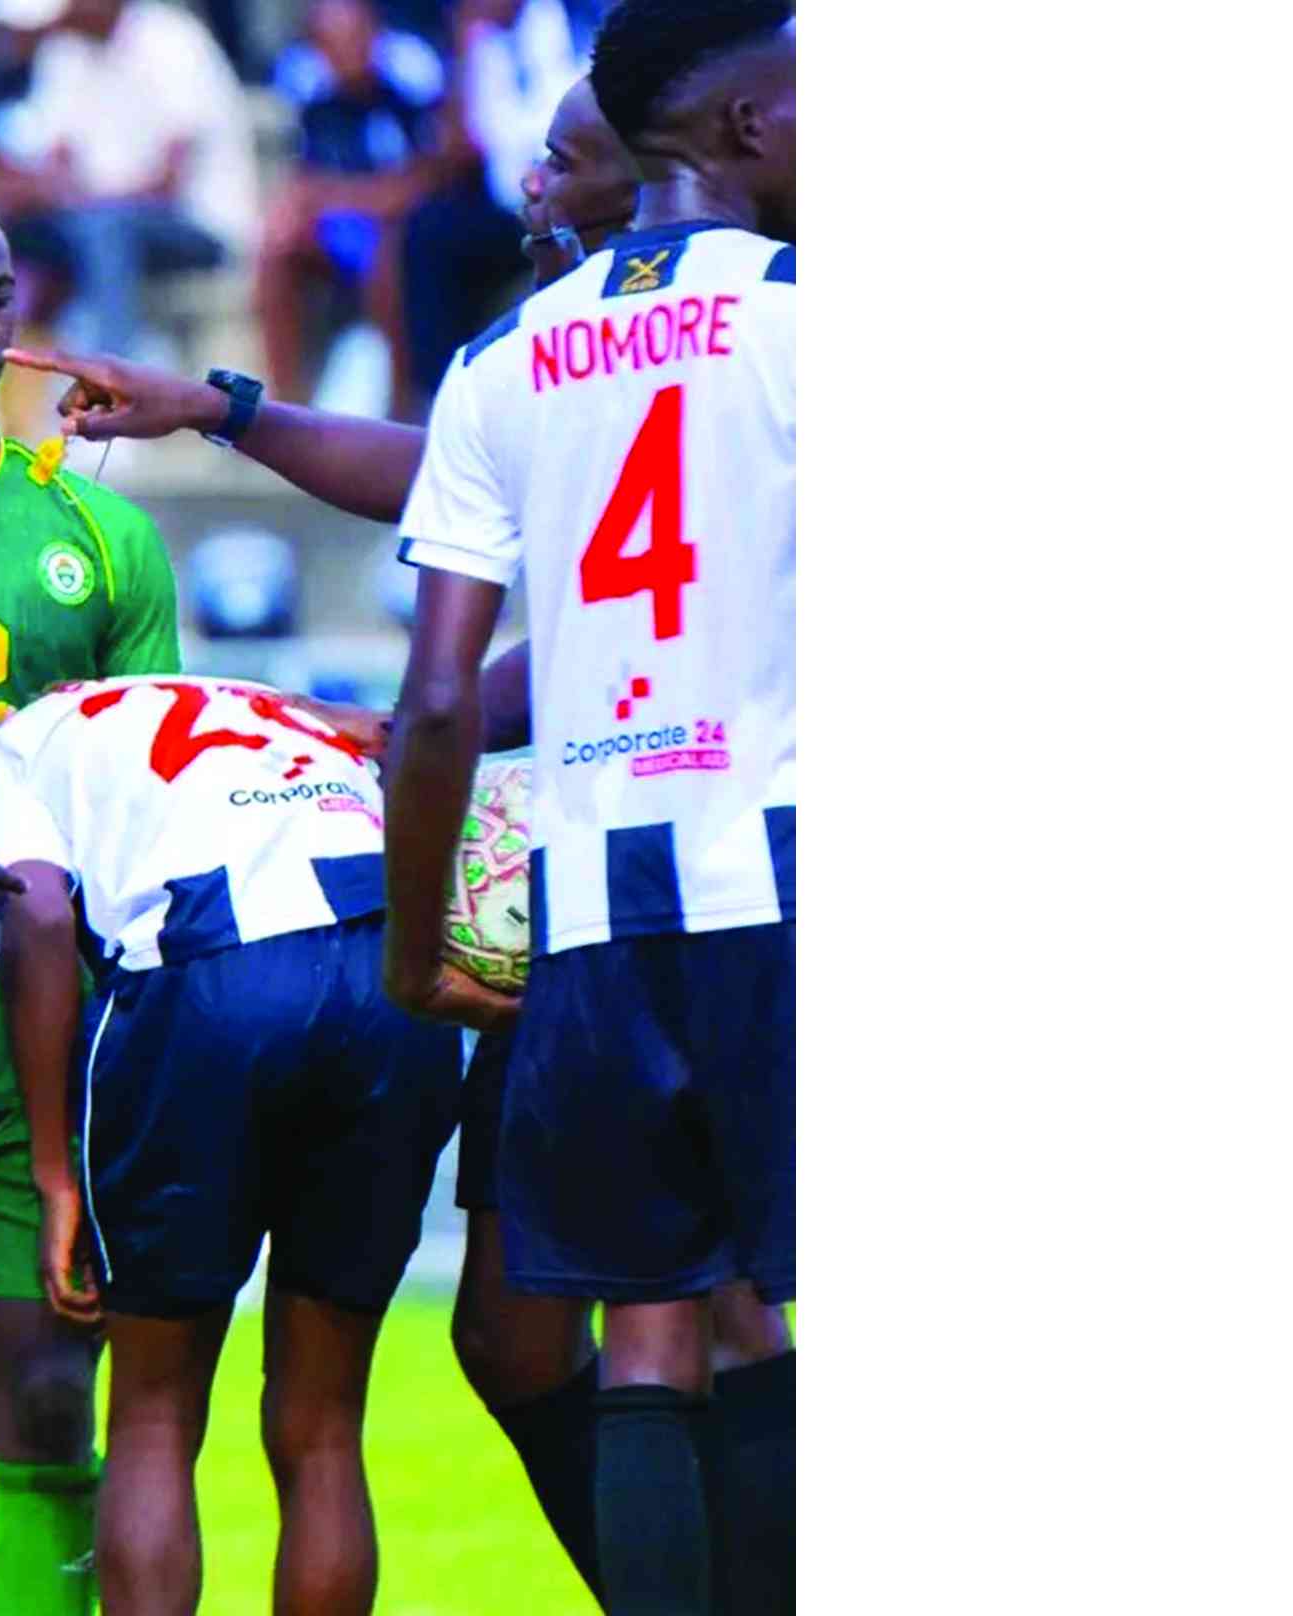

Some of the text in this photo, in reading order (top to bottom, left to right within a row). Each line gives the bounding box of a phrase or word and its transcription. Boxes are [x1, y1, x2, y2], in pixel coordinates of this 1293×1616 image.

[531, 295, 741, 393] NOMORE
[579, 383, 695, 641] 4
[563, 725, 687, 766] Corporate
[695, 719, 726, 743] 24
